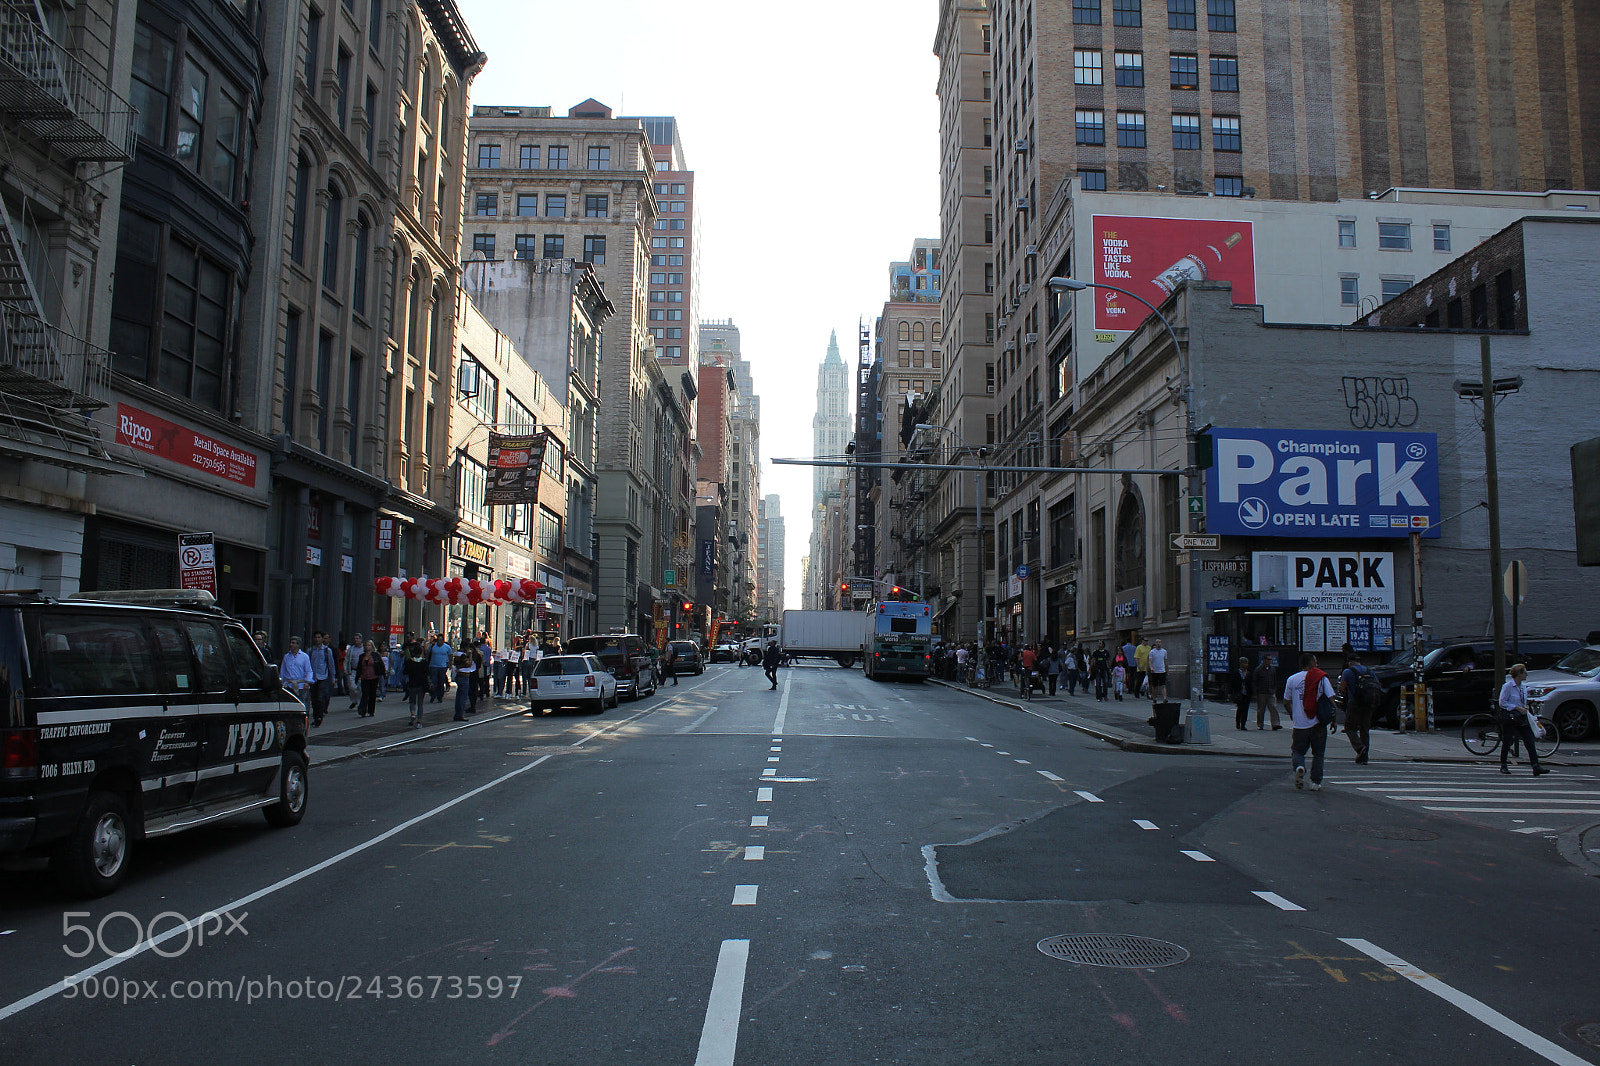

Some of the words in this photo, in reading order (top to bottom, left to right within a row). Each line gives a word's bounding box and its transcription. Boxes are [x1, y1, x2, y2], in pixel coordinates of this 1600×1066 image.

[1104, 231, 1117, 239] THE
[1103, 239, 1128, 247] VODKA
[1103, 247, 1122, 255] THAT
[1104, 255, 1131, 263] TASTES
[1104, 262, 1120, 271] LIKE
[1105, 270, 1132, 278] VODKA.
[121, 415, 152, 444] Ripco
[194, 436, 212, 451] Retail
[213, 443, 230, 458] Space
[230, 450, 256, 467] Available
[1277, 440, 1360, 456] Champion
[193, 454, 226, 474] 212.750.6565
[503, 471, 520, 479] NIKE
[1217, 438, 1430, 507] Park
[1273, 513, 1316, 527] OPEN
[1321, 514, 1360, 527] LATE
[465, 540, 487, 561] TRANSIT
[1204, 561, 1237, 571] LISPENARD
[1240, 562, 1248, 571] ST
[1295, 557, 1385, 588] PARK
[1115, 602, 1131, 617] CHASE
[1373, 617, 1391, 628] PARK
[1351, 632, 1369, 640] 19.43
[1210, 652, 1228, 660] 29.57
[40, 726, 68, 739] TRAFFIC
[69, 722, 111, 736] ENFORCEMENT
[224, 721, 275, 757] NYPD
[41, 763, 58, 778] 7006
[84, 760, 95, 773] PED
